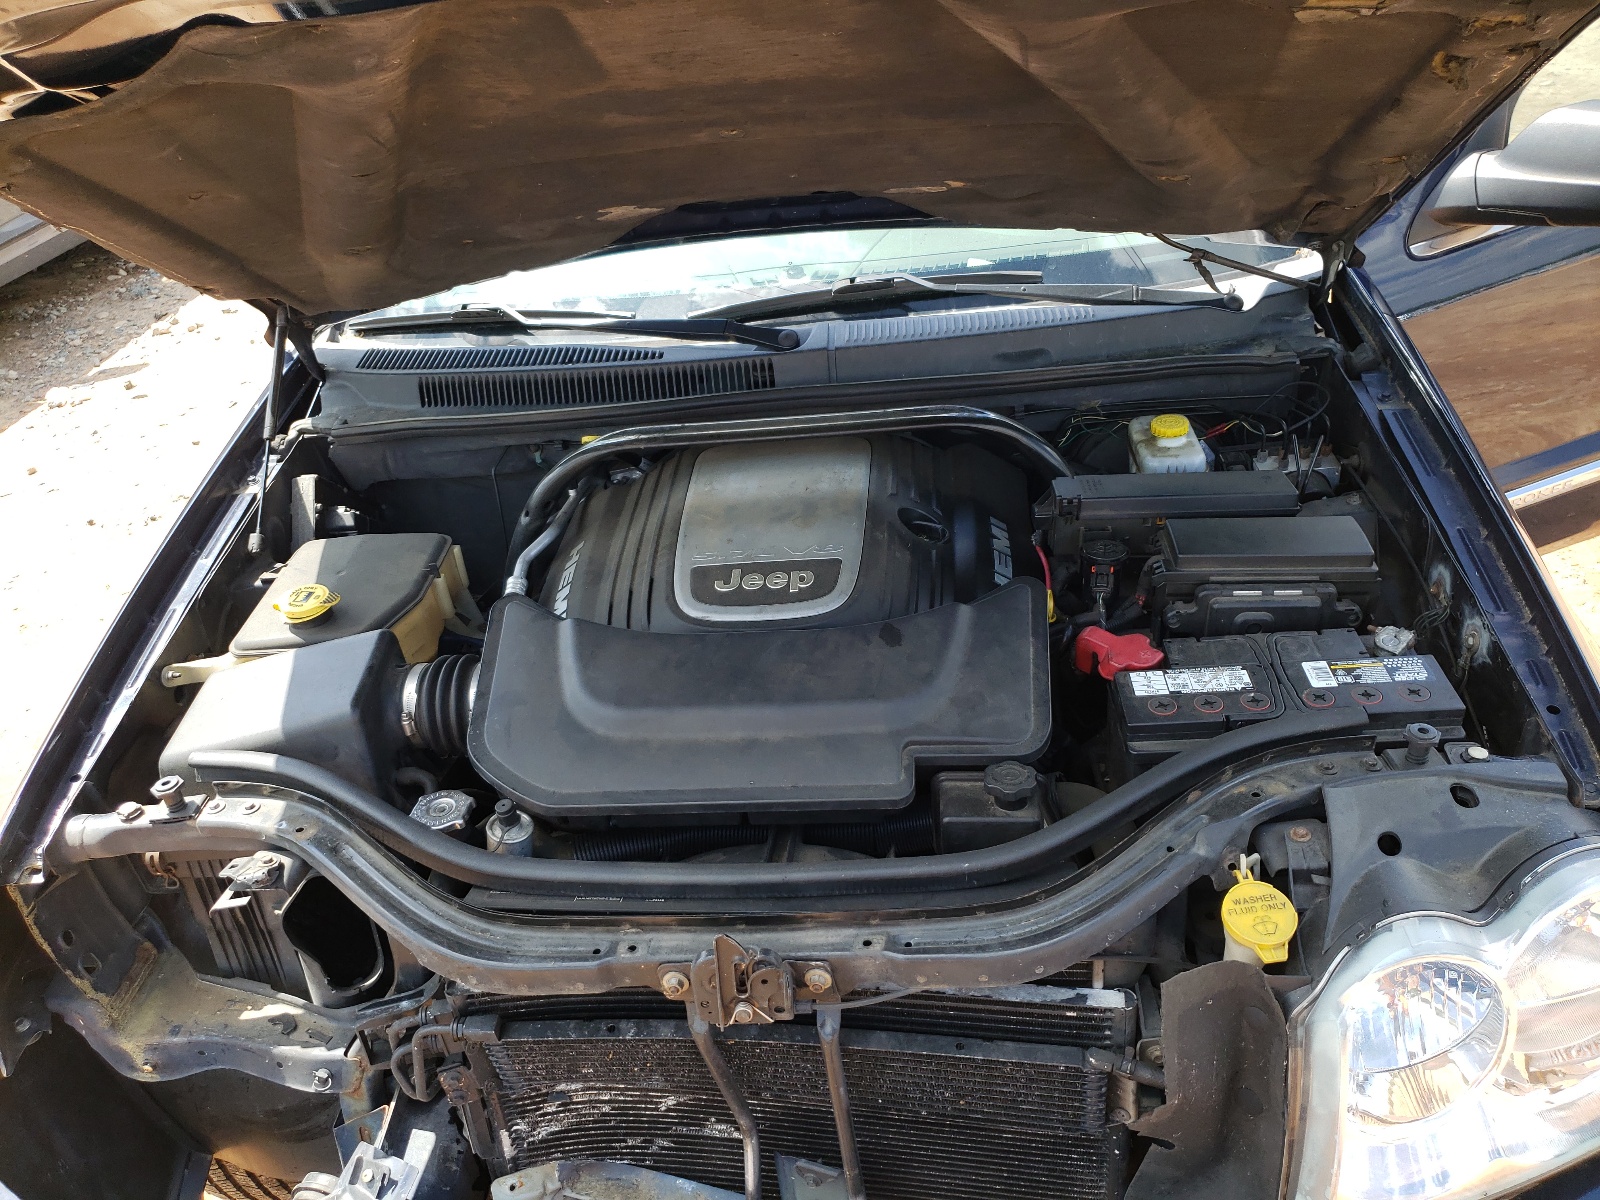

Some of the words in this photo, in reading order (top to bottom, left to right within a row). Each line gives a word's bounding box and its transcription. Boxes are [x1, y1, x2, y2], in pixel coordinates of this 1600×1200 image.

[714, 568, 815, 592] Jeep
[1232, 894, 1277, 905] WASHER
[1228, 905, 1258, 916] FLUID
[1261, 902, 1287, 911] ONLY
